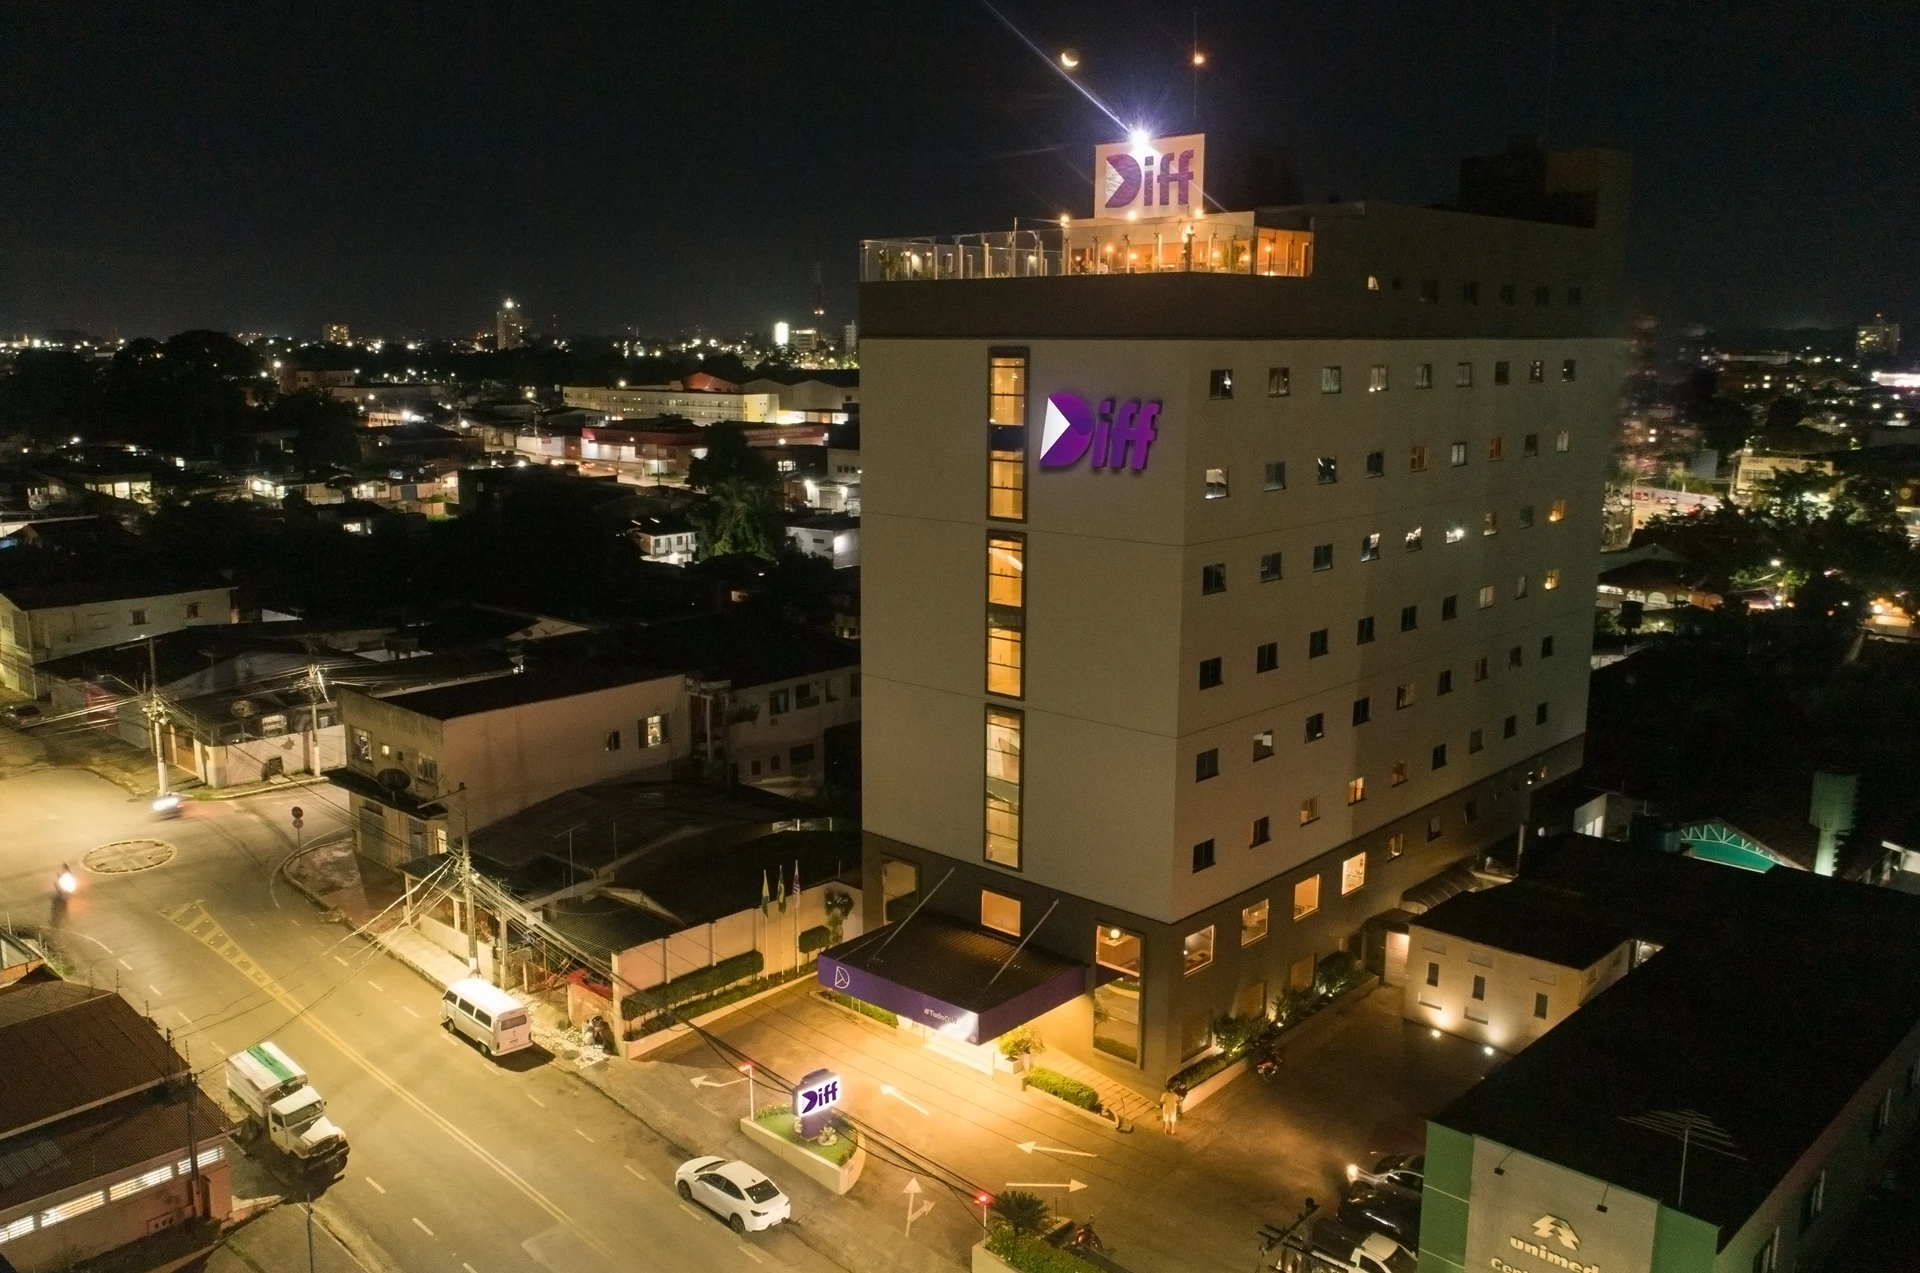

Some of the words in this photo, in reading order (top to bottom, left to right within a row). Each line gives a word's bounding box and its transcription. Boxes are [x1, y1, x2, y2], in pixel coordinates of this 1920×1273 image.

[1105, 149, 1195, 208] Diff
[1040, 392, 1162, 471] Diff
[802, 1081, 838, 1114] Diff
[1510, 1236, 1600, 1273] unimed
